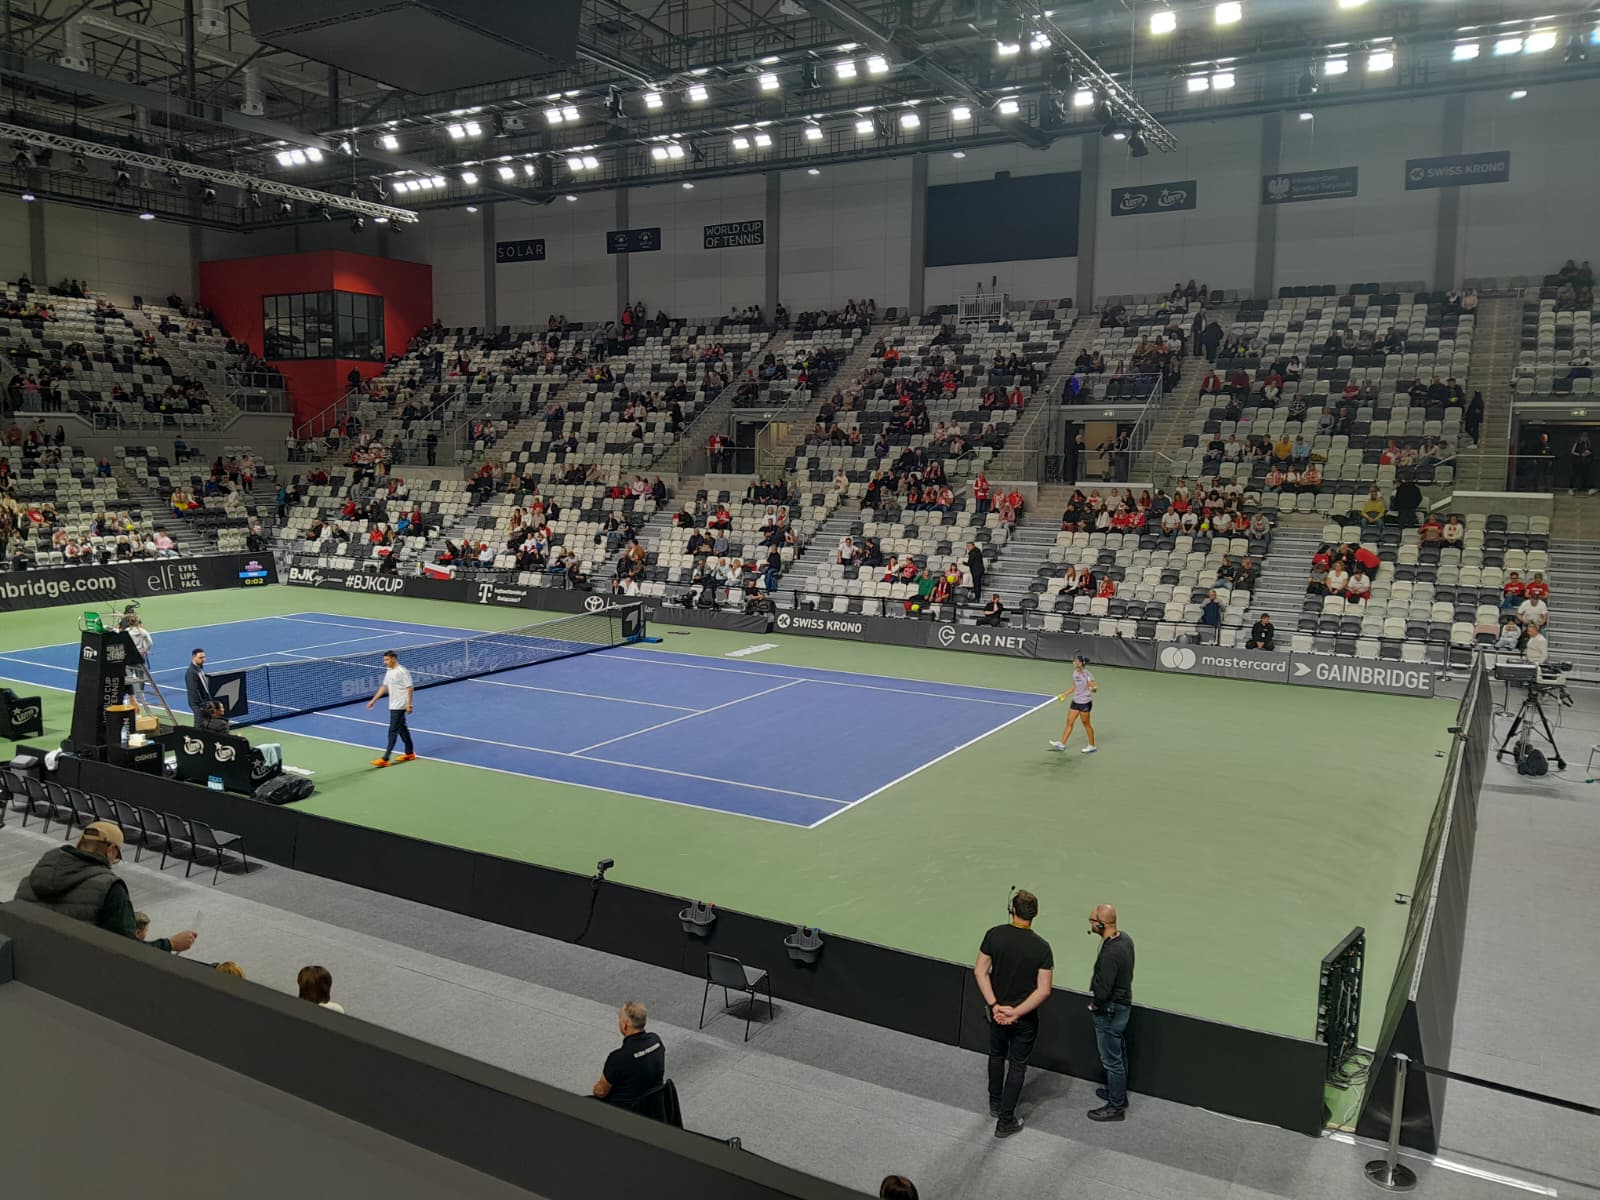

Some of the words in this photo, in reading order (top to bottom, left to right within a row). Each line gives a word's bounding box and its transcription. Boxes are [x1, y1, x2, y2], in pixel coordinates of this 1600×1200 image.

[1427, 166, 1463, 178] SWISS
[1465, 161, 1505, 175] KRONO
[705, 224, 740, 236] WORLD
[742, 222, 761, 232] CUP
[705, 236, 721, 248] OF
[723, 233, 761, 246] TENNIS
[497, 244, 544, 258] SOLAR
[345, 574, 404, 593] #BJKCUP
[792, 617, 824, 630] SWISS
[826, 620, 862, 633] KRONO
[960, 632, 990, 646] CAR
[995, 635, 1026, 649] NET
[1201, 654, 1286, 673] mastercard
[1315, 663, 1431, 690] GAINBRIDGE
